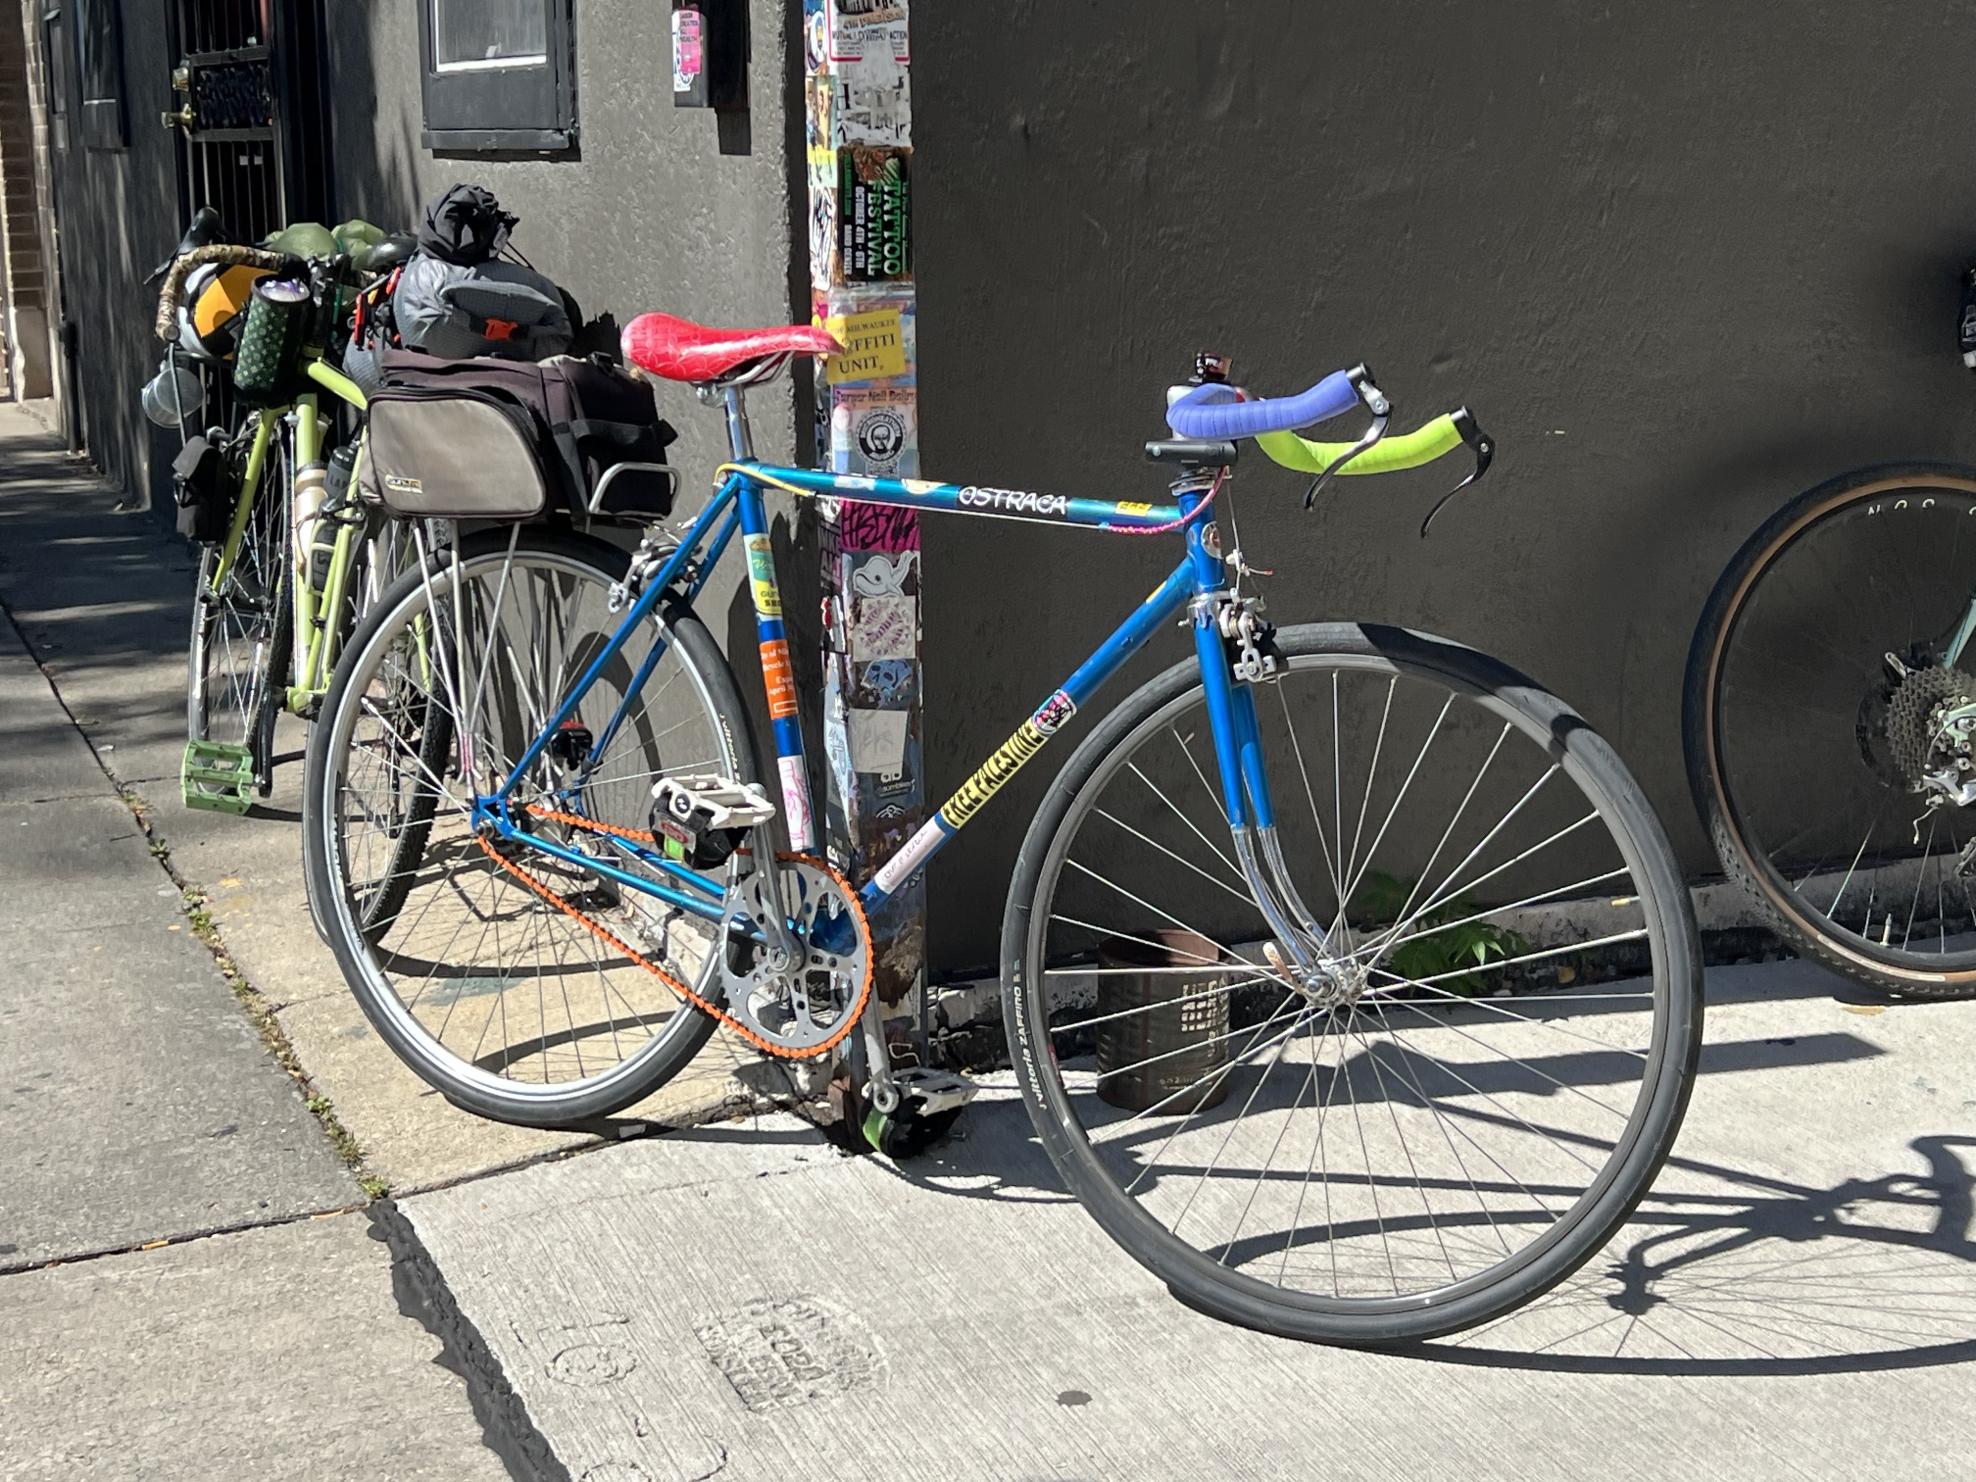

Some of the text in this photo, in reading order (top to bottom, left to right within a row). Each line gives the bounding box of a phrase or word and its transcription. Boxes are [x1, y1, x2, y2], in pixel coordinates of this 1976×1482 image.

[855, 186, 865, 225] OCTOBER
[867, 180, 882, 276] FESTIVAL
[883, 180, 901, 275] TATTOO
[942, 723, 1045, 828] FREE PALESTINE
[1013, 985, 1028, 1046] ZAFFIRO
[1022, 1047, 1044, 1102] vittoria
